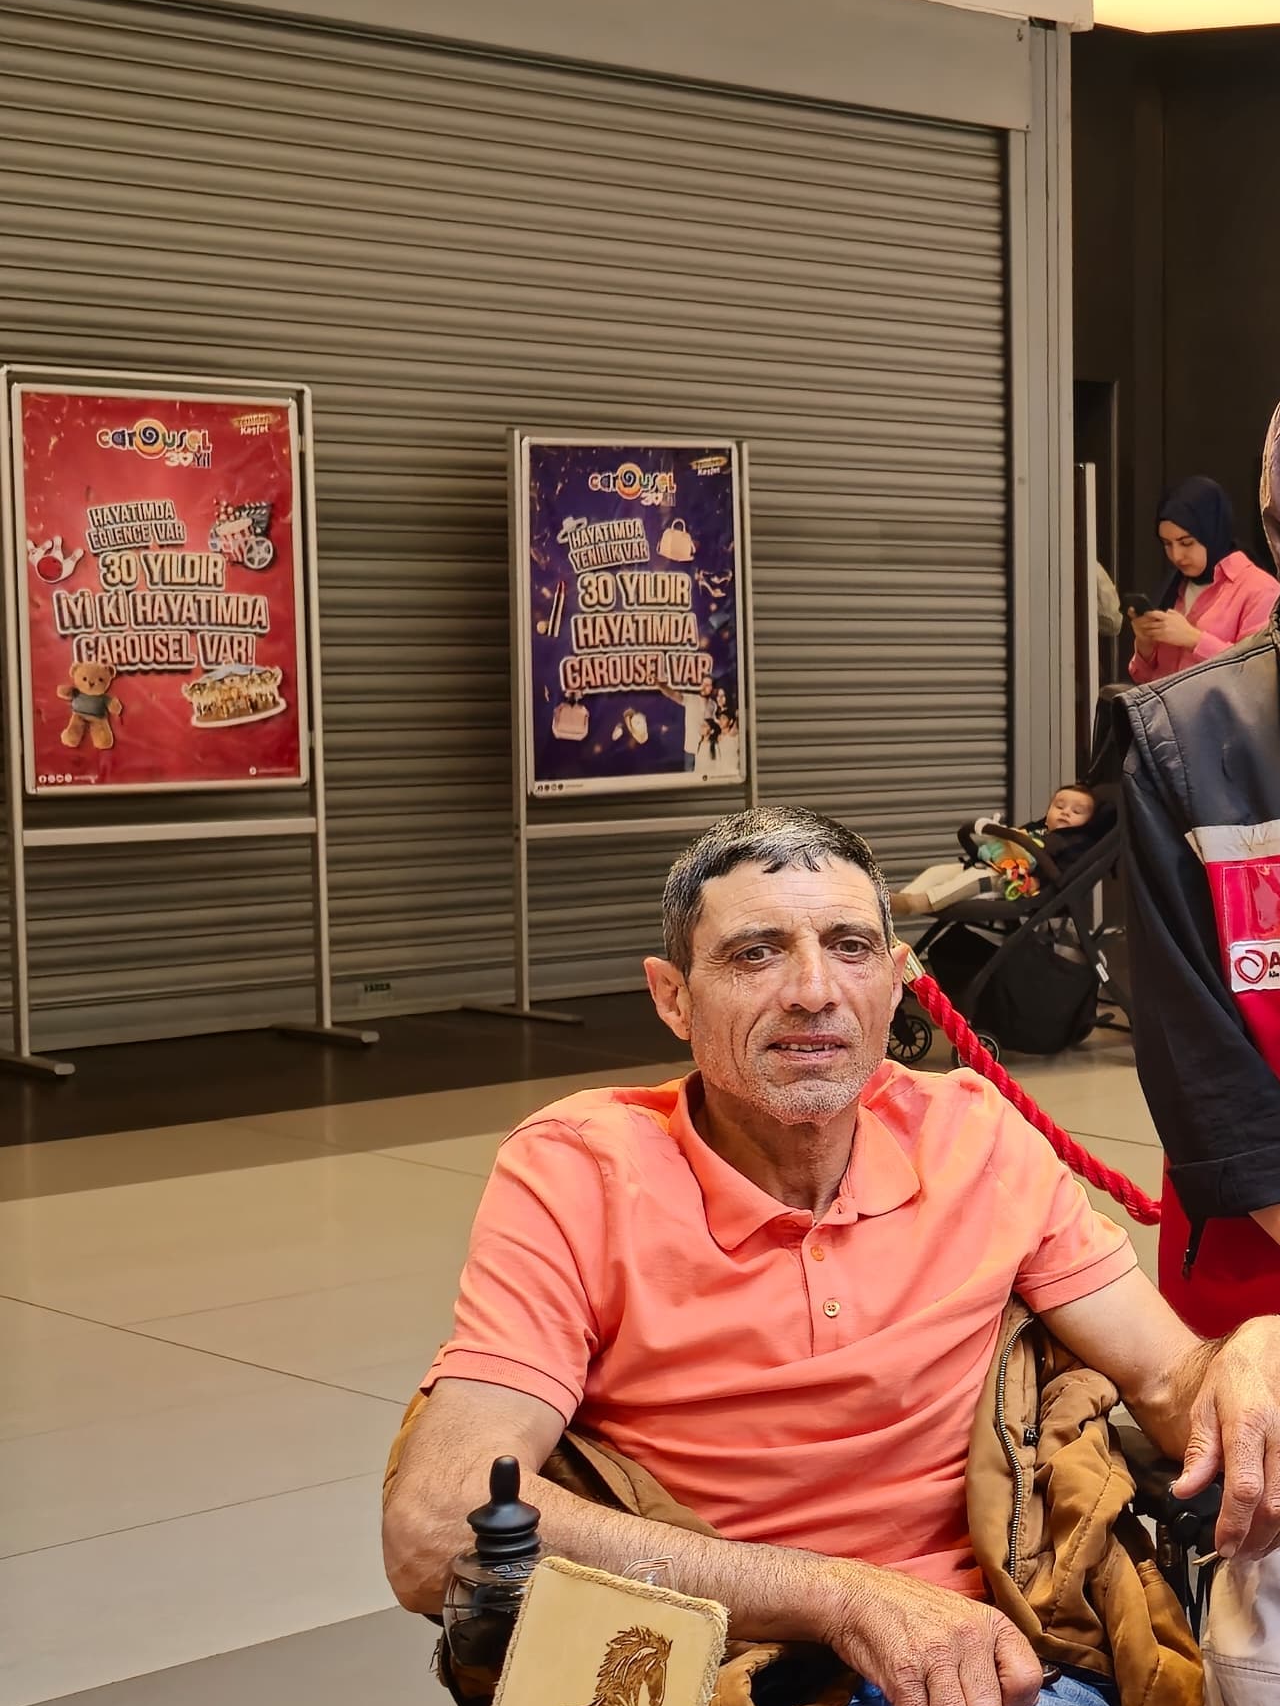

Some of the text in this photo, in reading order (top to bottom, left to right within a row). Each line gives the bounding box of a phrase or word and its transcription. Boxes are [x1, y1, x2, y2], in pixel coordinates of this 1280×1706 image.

[90, 501, 175, 527] HAYATIMDA
[155, 522, 185, 542] VAR
[571, 520, 644, 549] HAYATIMDA
[622, 540, 649, 561] VAR
[102, 552, 225, 588] 30 YILDIR
[580, 573, 690, 607] 30 YILDIR
[131, 595, 268, 627] HAYATIMDA
[575, 614, 698, 649] HAYATIMDA
[77, 634, 255, 666] CAROUSEL VAR!
[563, 654, 668, 690] CAROUSEL
